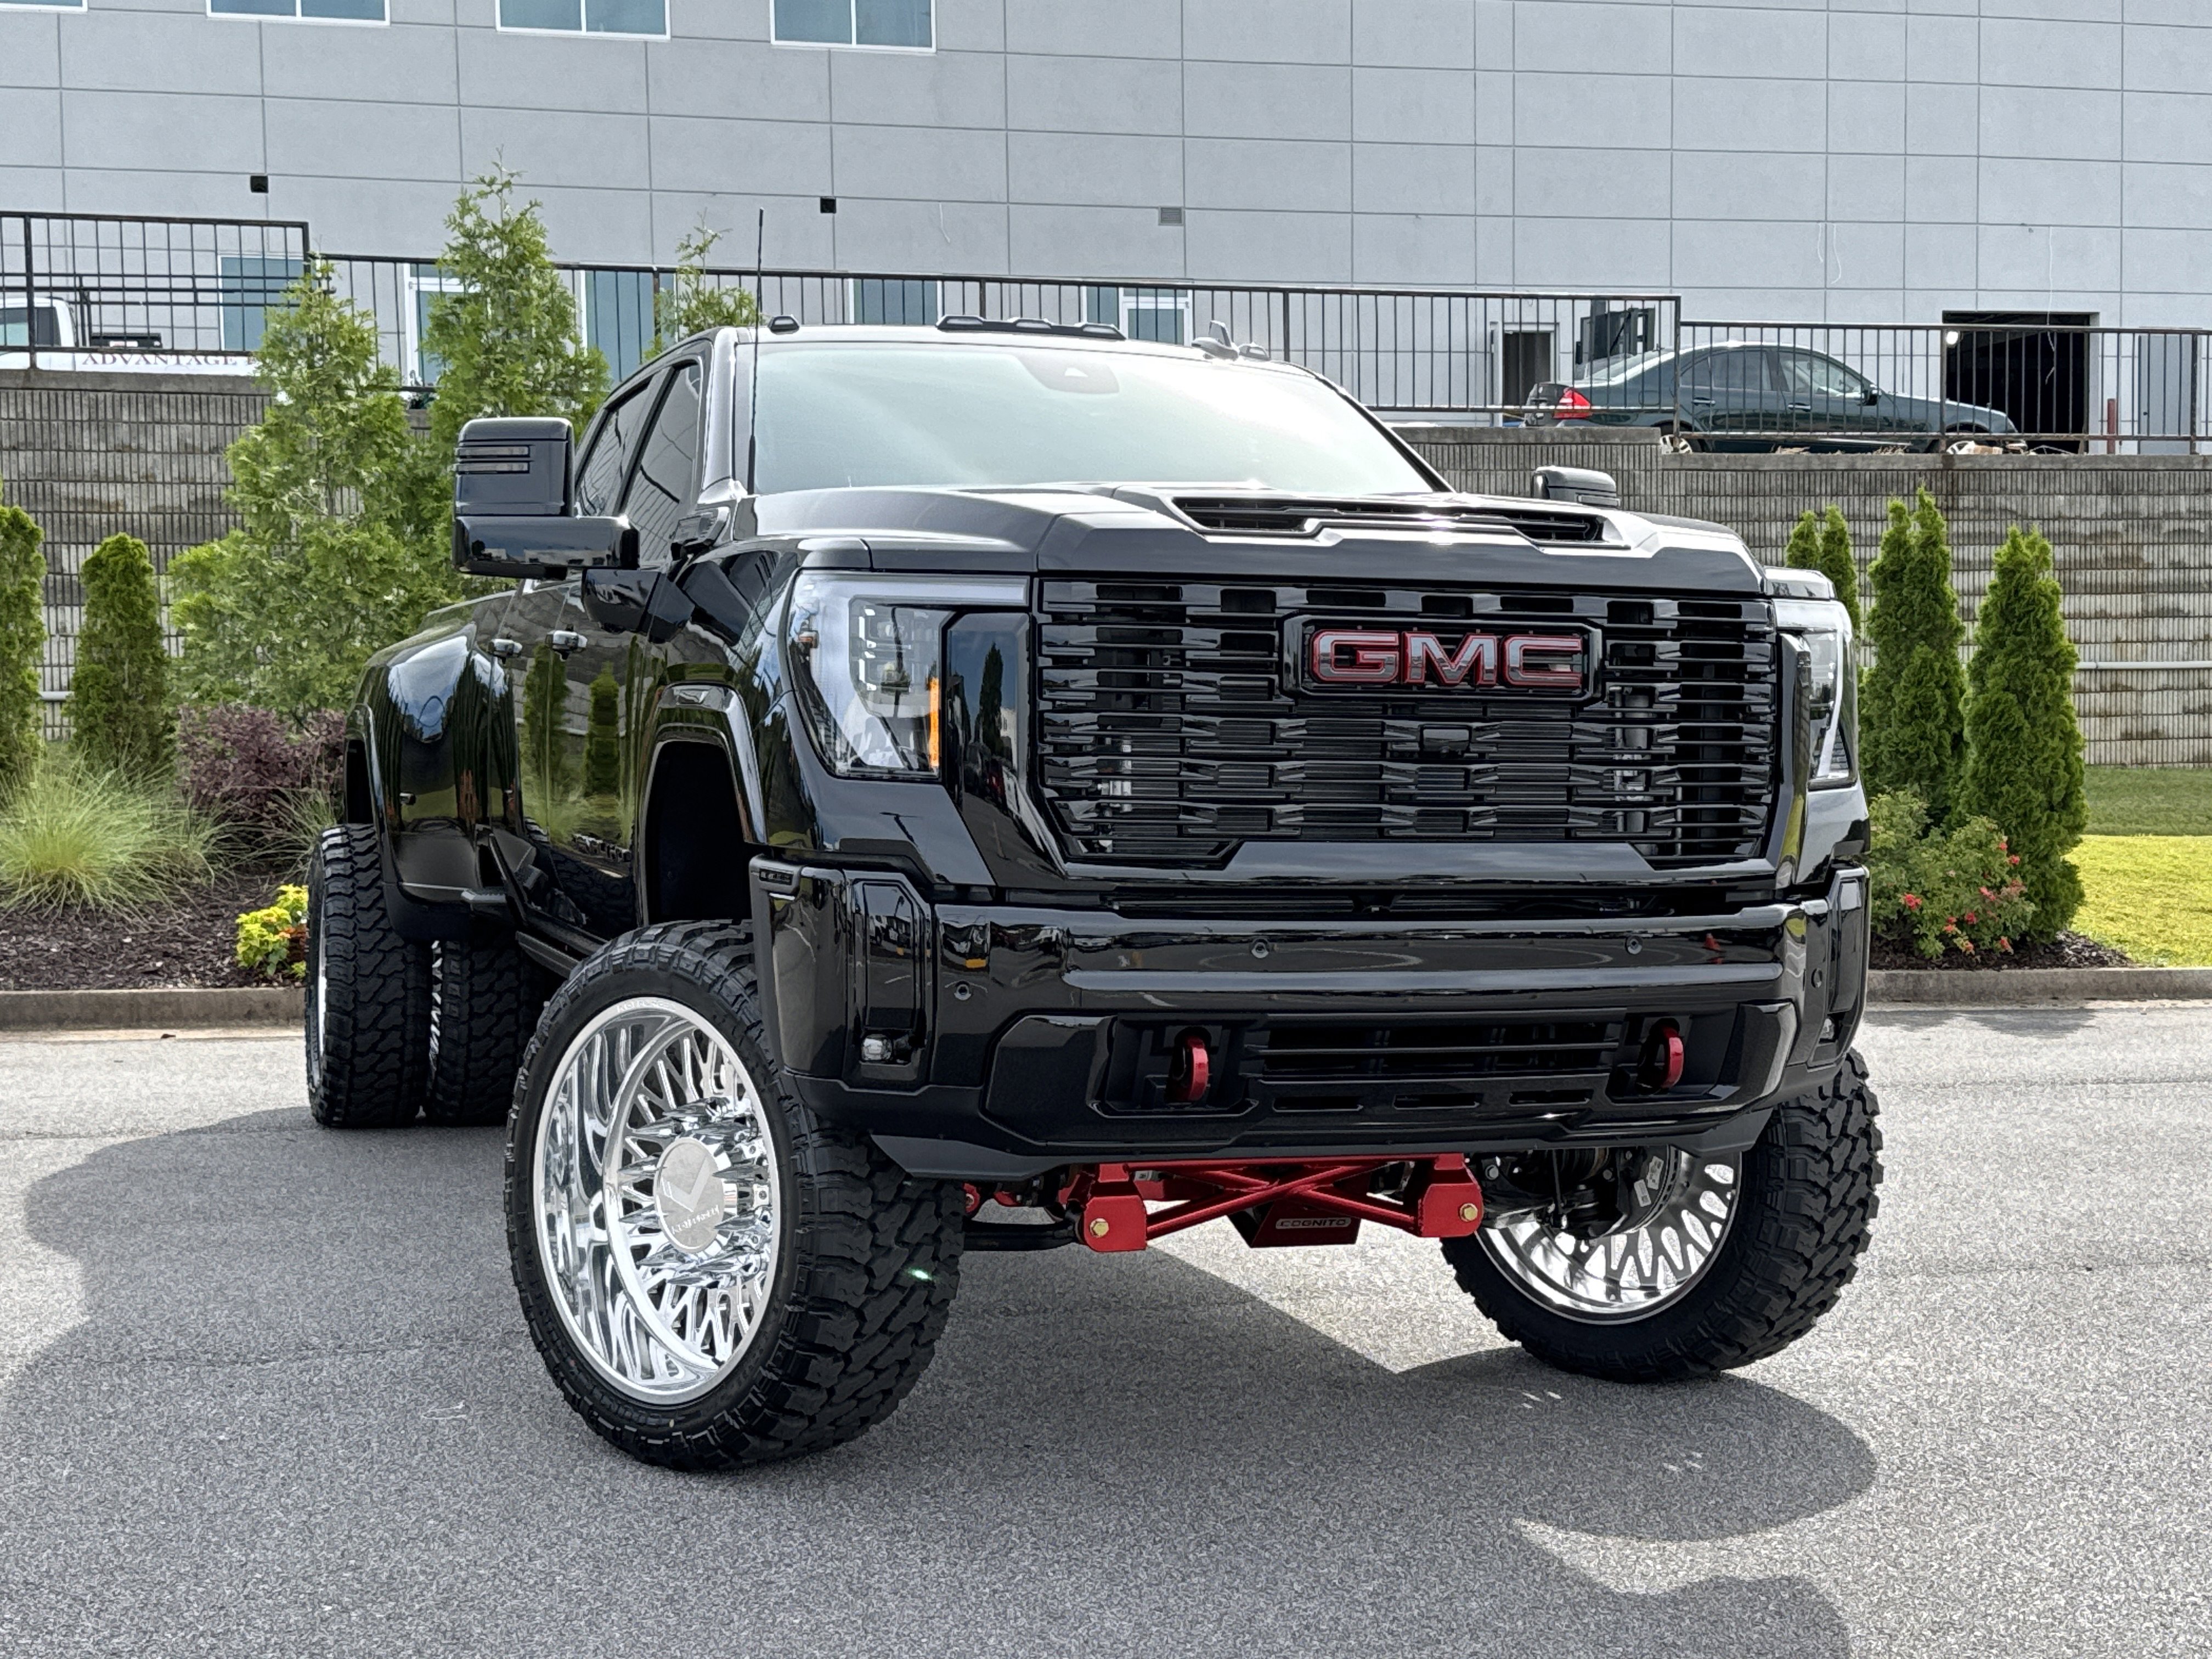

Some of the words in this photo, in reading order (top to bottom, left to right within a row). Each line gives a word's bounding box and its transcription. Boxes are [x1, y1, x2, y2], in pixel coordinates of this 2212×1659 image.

[82, 353, 237, 365] ADVANTAGE
[1311, 629, 1582, 686] GMC
[1279, 1218, 1346, 1227] COGNITO
